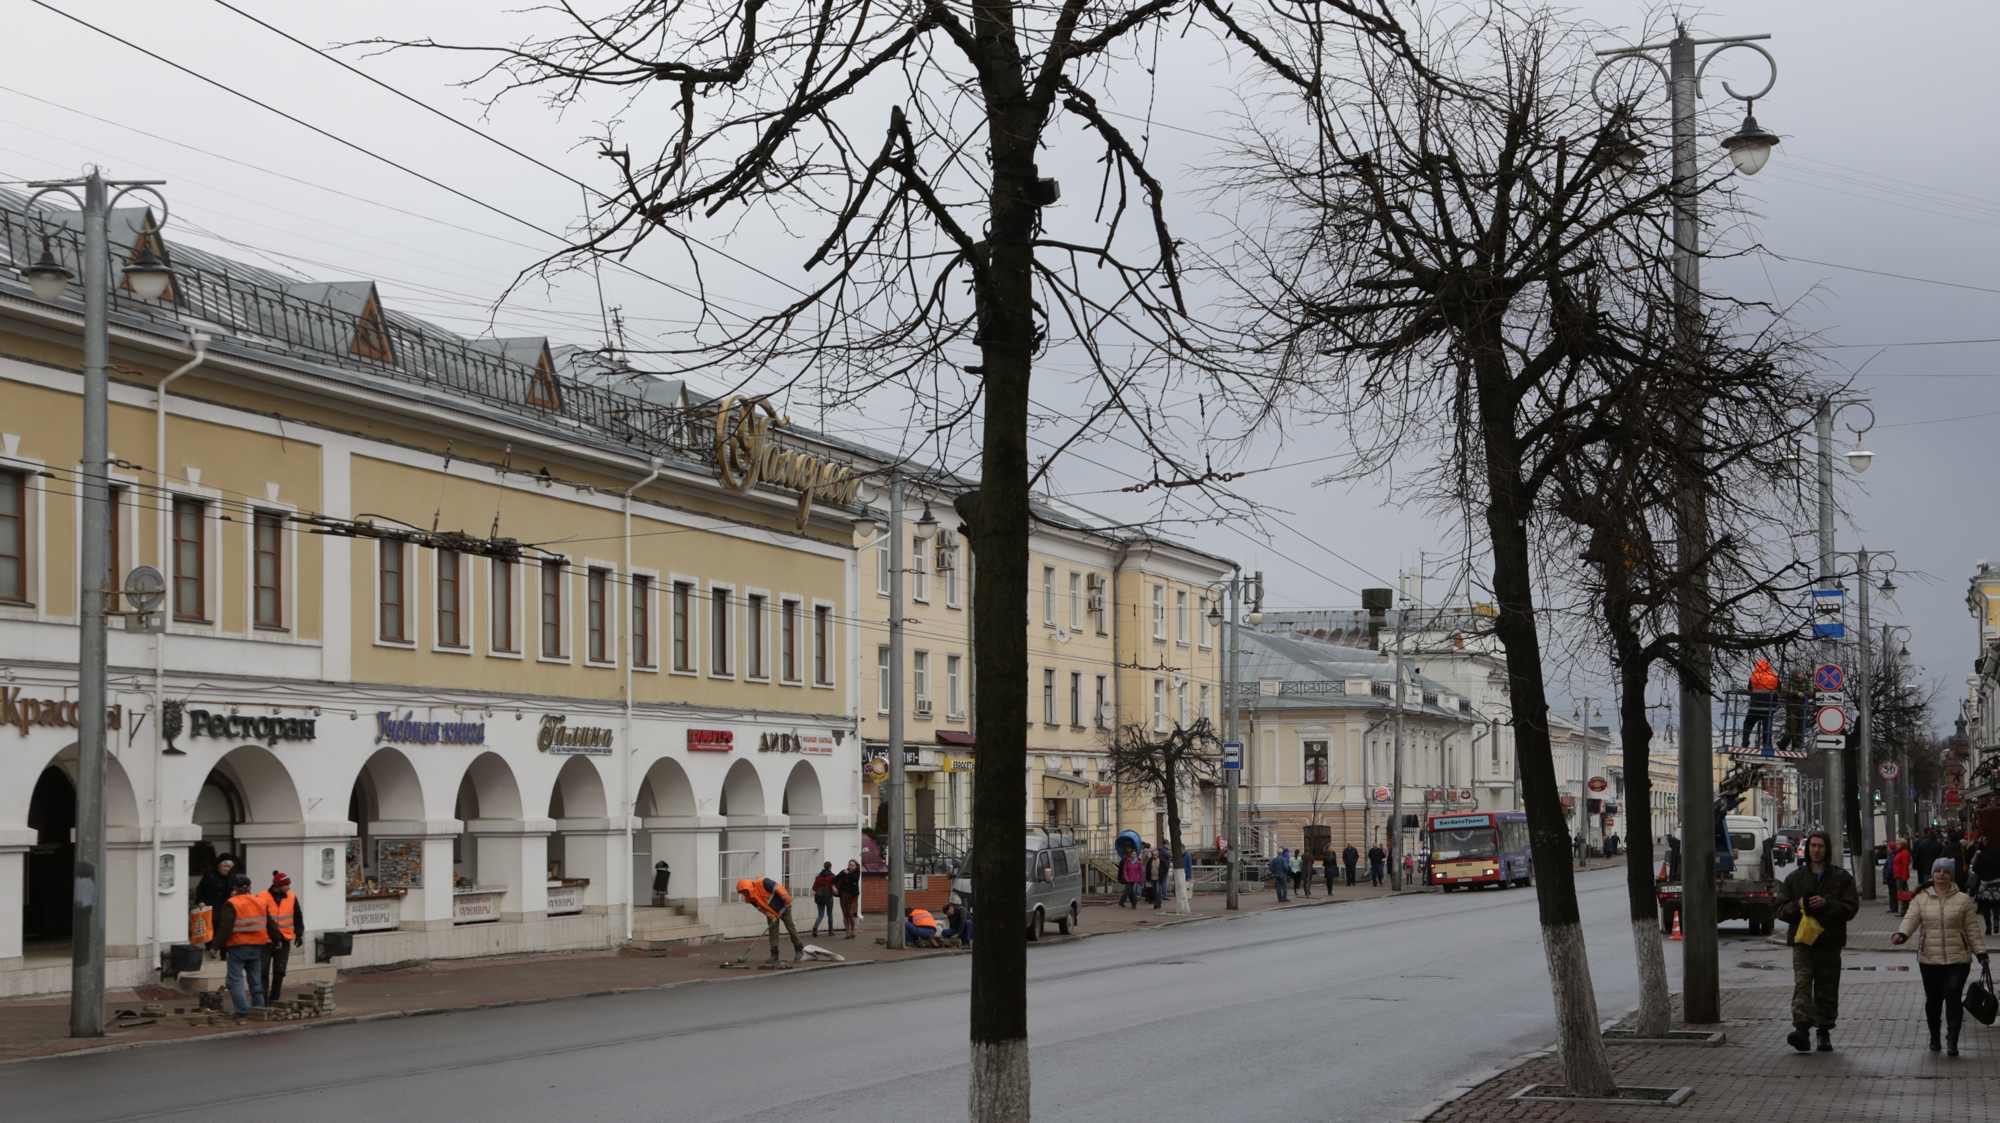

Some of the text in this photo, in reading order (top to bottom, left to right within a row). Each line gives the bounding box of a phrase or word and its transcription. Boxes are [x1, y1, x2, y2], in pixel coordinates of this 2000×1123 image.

[0, 686, 122, 736] Красоы
[190, 709, 316, 745] Ресторан
[376, 709, 485, 744] Учебная книга
[537, 714, 613, 752] Галина
[758, 731, 802, 753] ДИВА
[952, 760, 975, 771] ЕВРОСЕТЬ
[1882, 765, 1896, 774] 50
[1439, 818, 1484, 826] БигАвтоТранс
[352, 912, 390, 926] СУВЕНИРЫ
[459, 905, 491, 917] СУВЕНИРЫ
